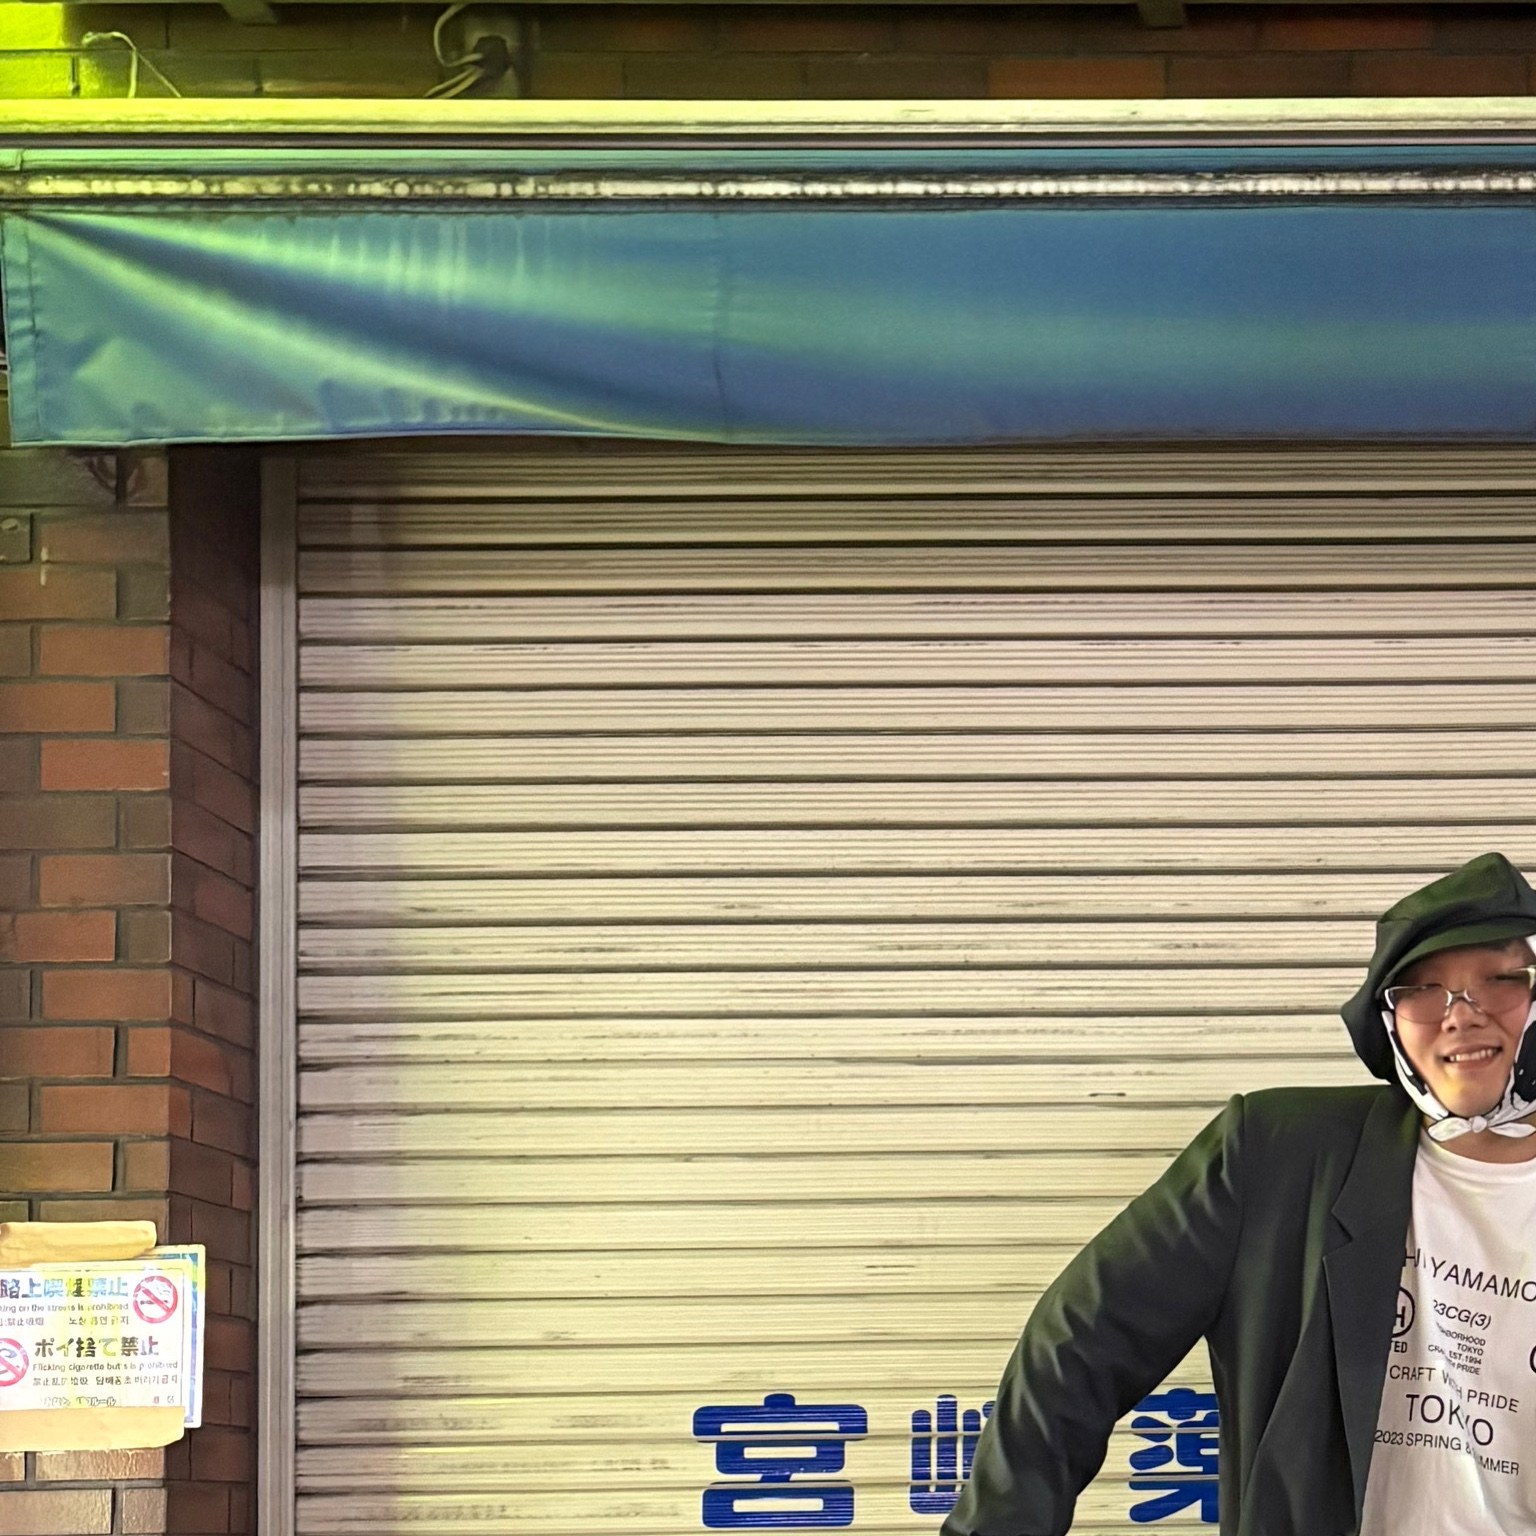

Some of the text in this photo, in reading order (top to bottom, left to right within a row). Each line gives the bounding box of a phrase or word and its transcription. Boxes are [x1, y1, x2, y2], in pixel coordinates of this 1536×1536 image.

[35, 1335, 159, 1358] ポイ捨て禁止
[1457, 1342, 1484, 1356] TOKYO
[1389, 1365, 1436, 1381] CRAFT
[1467, 1389, 1519, 1413] PRIDE
[1375, 1430, 1404, 1445] 2023
[1406, 1433, 1461, 1451] SPRING
